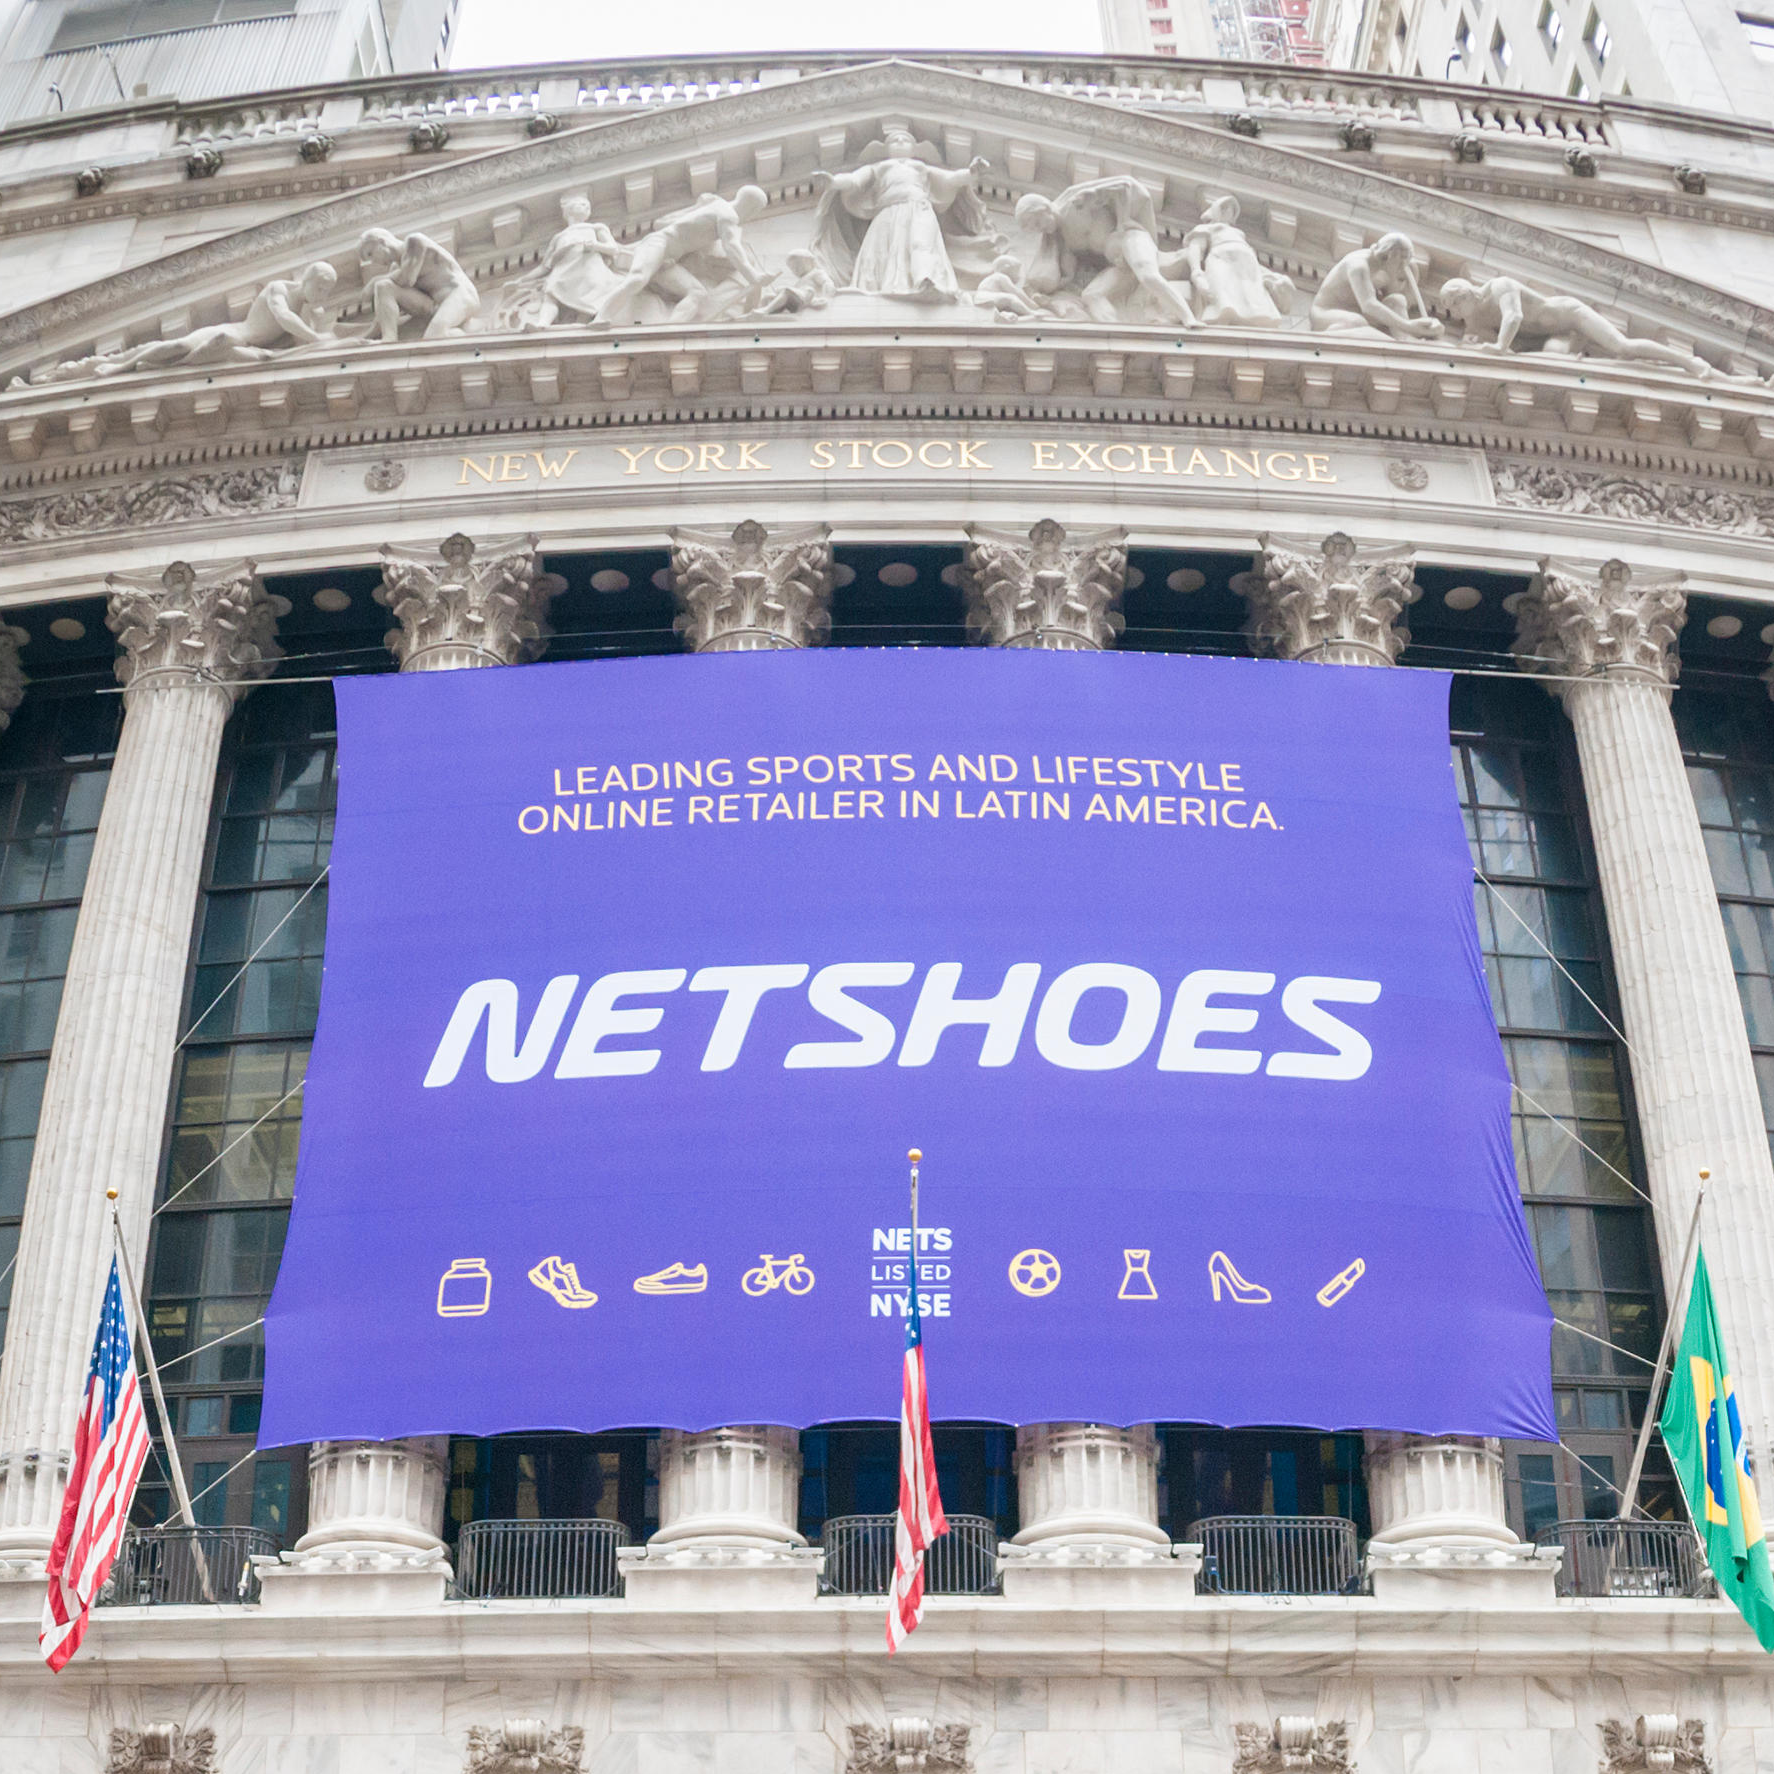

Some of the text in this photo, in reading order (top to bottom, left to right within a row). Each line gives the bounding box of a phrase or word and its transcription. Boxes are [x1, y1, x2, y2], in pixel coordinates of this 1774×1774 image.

[458, 438, 1338, 486] NEW YORK STOCK EXCHANGE
[554, 753, 1245, 796] LEADING SPORTS AND LIFESTYLE
[517, 789, 1285, 835] ONLINE RETAILER IN LATIN AMERICA.
[422, 961, 1382, 1088] NETSHOES
[872, 1228, 953, 1251] NETS
[871, 1264, 952, 1281] LISED
[870, 1293, 952, 1318] NYSE
